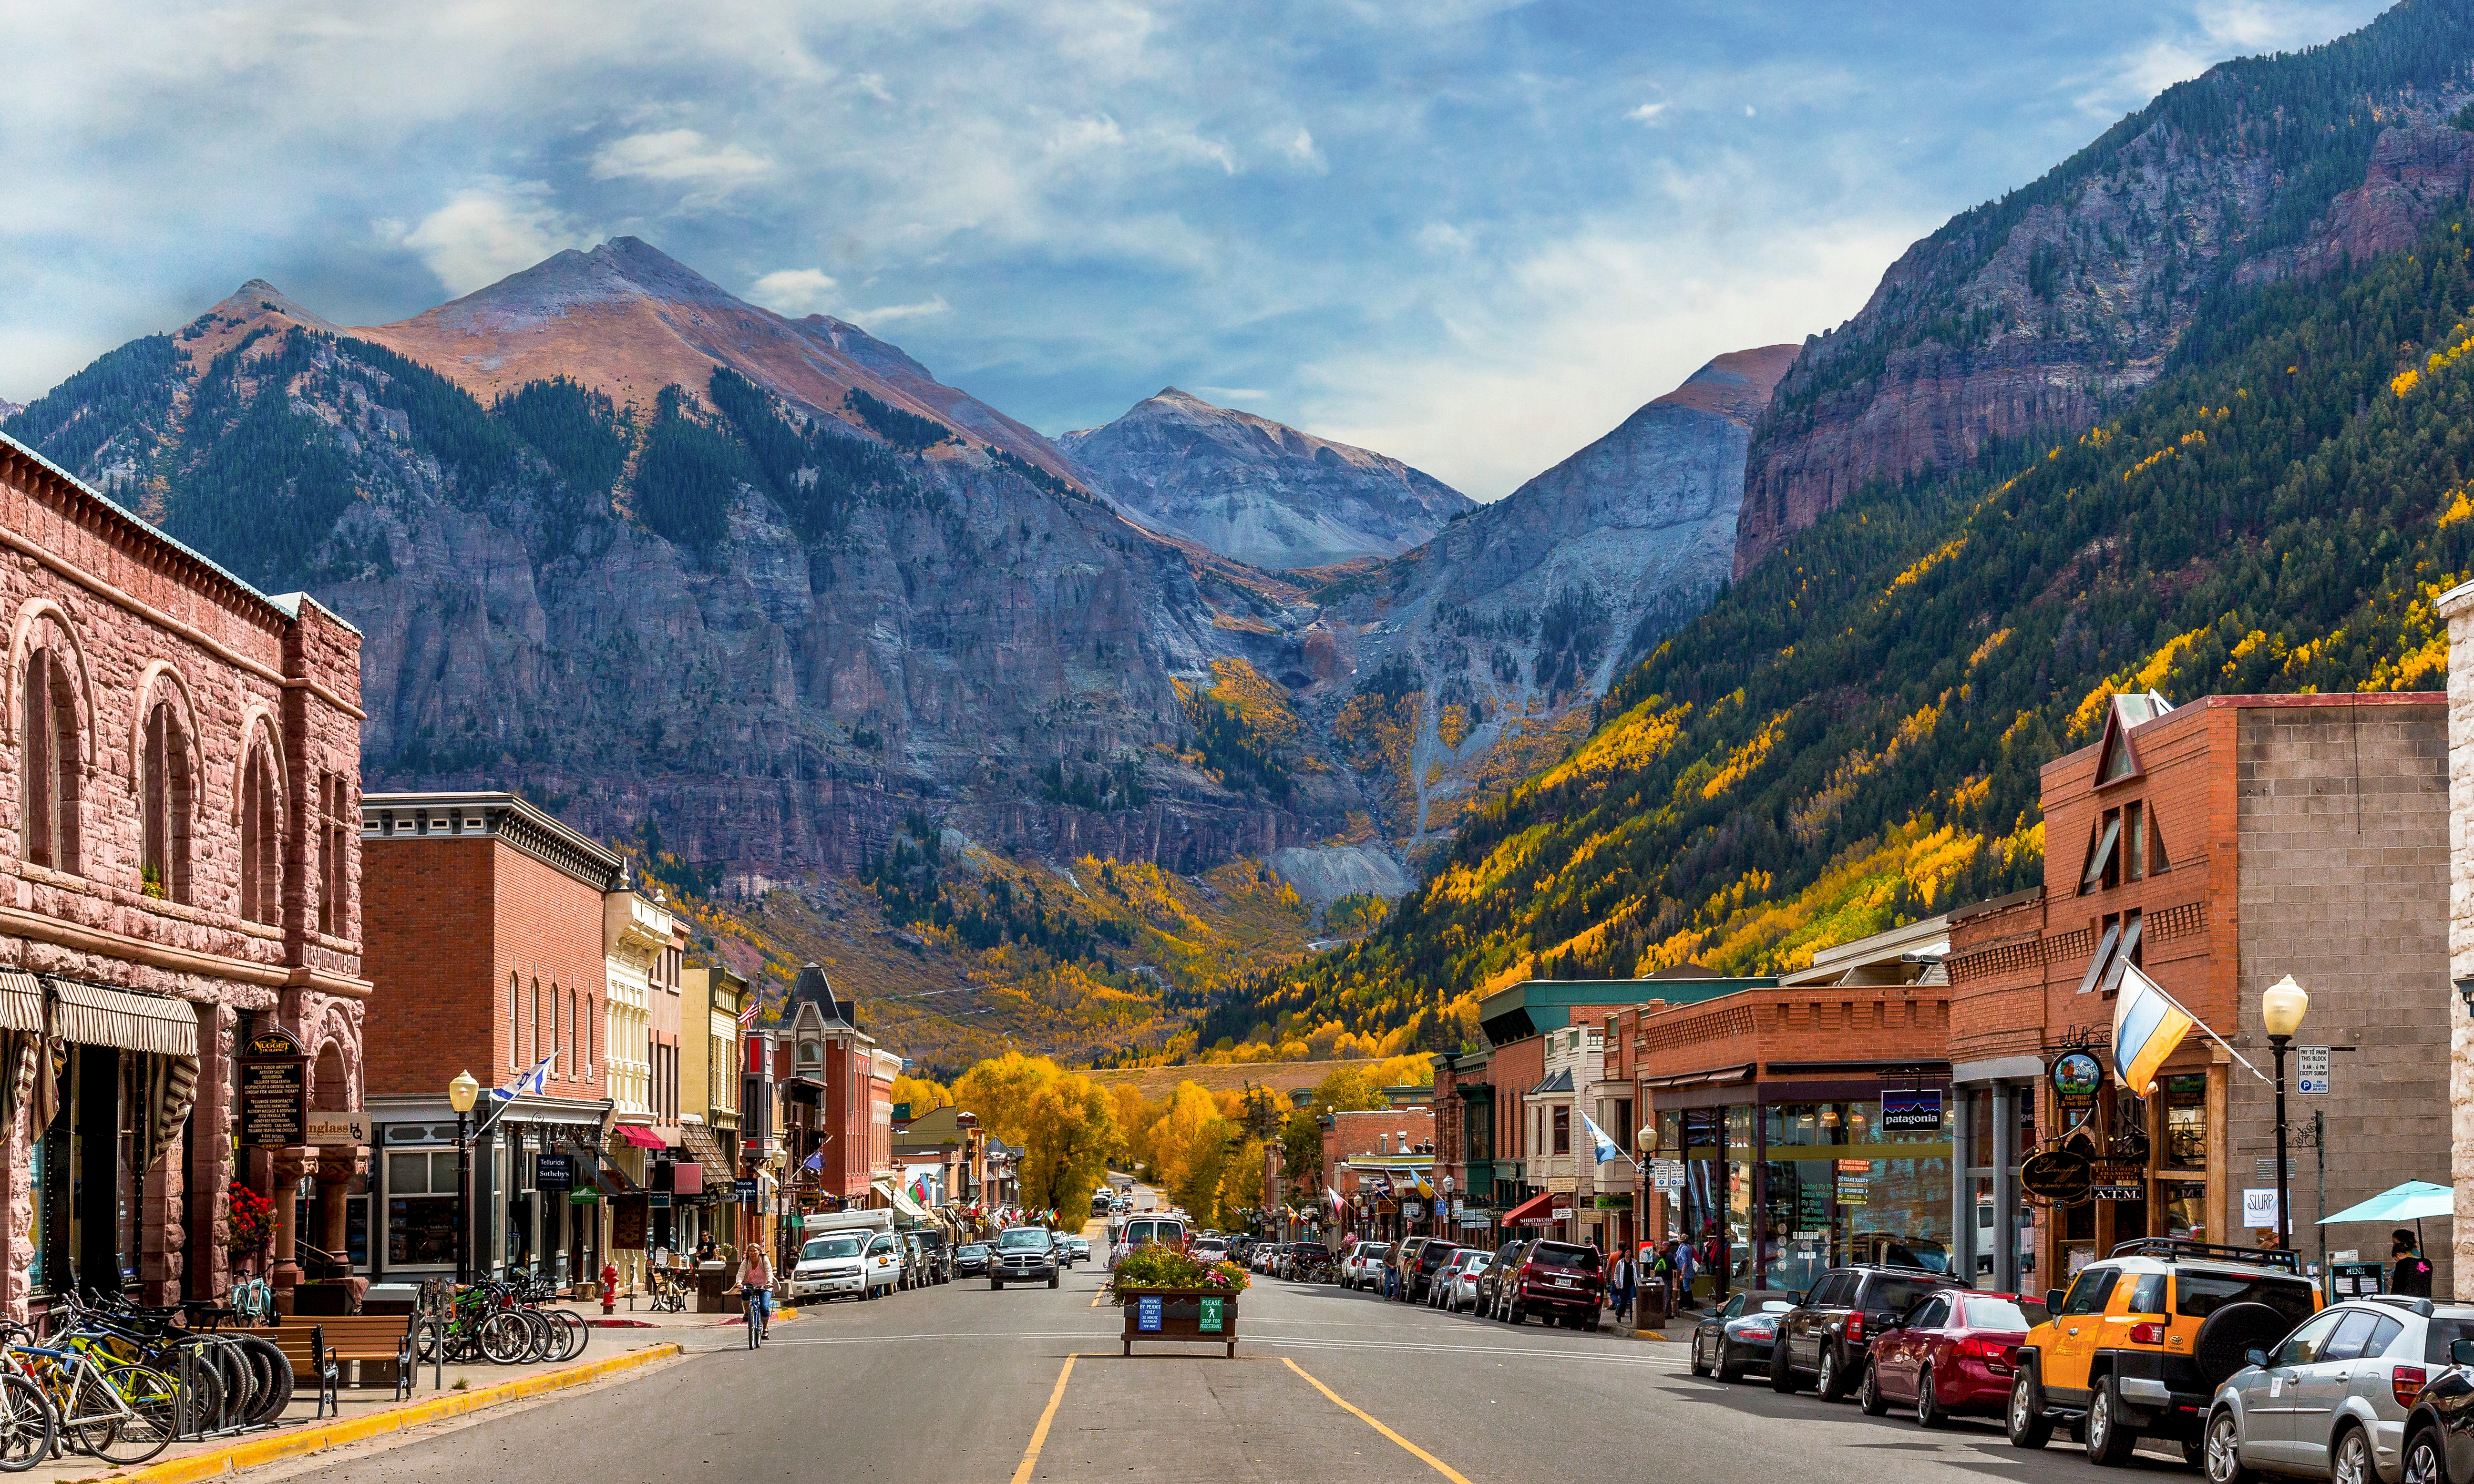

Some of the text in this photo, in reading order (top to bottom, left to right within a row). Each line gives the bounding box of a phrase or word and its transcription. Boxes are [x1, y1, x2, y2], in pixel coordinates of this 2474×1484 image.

[304, 944, 360, 975] FIRST NATIONAL BANK
[255, 1041, 290, 1053] NUGGET
[1886, 1115, 1938, 1125] patagonia
[2094, 1190, 2139, 1198] A.T.M.
[1600, 1198, 1632, 1207] sublime
[2248, 1194, 2273, 1210] SLURP
